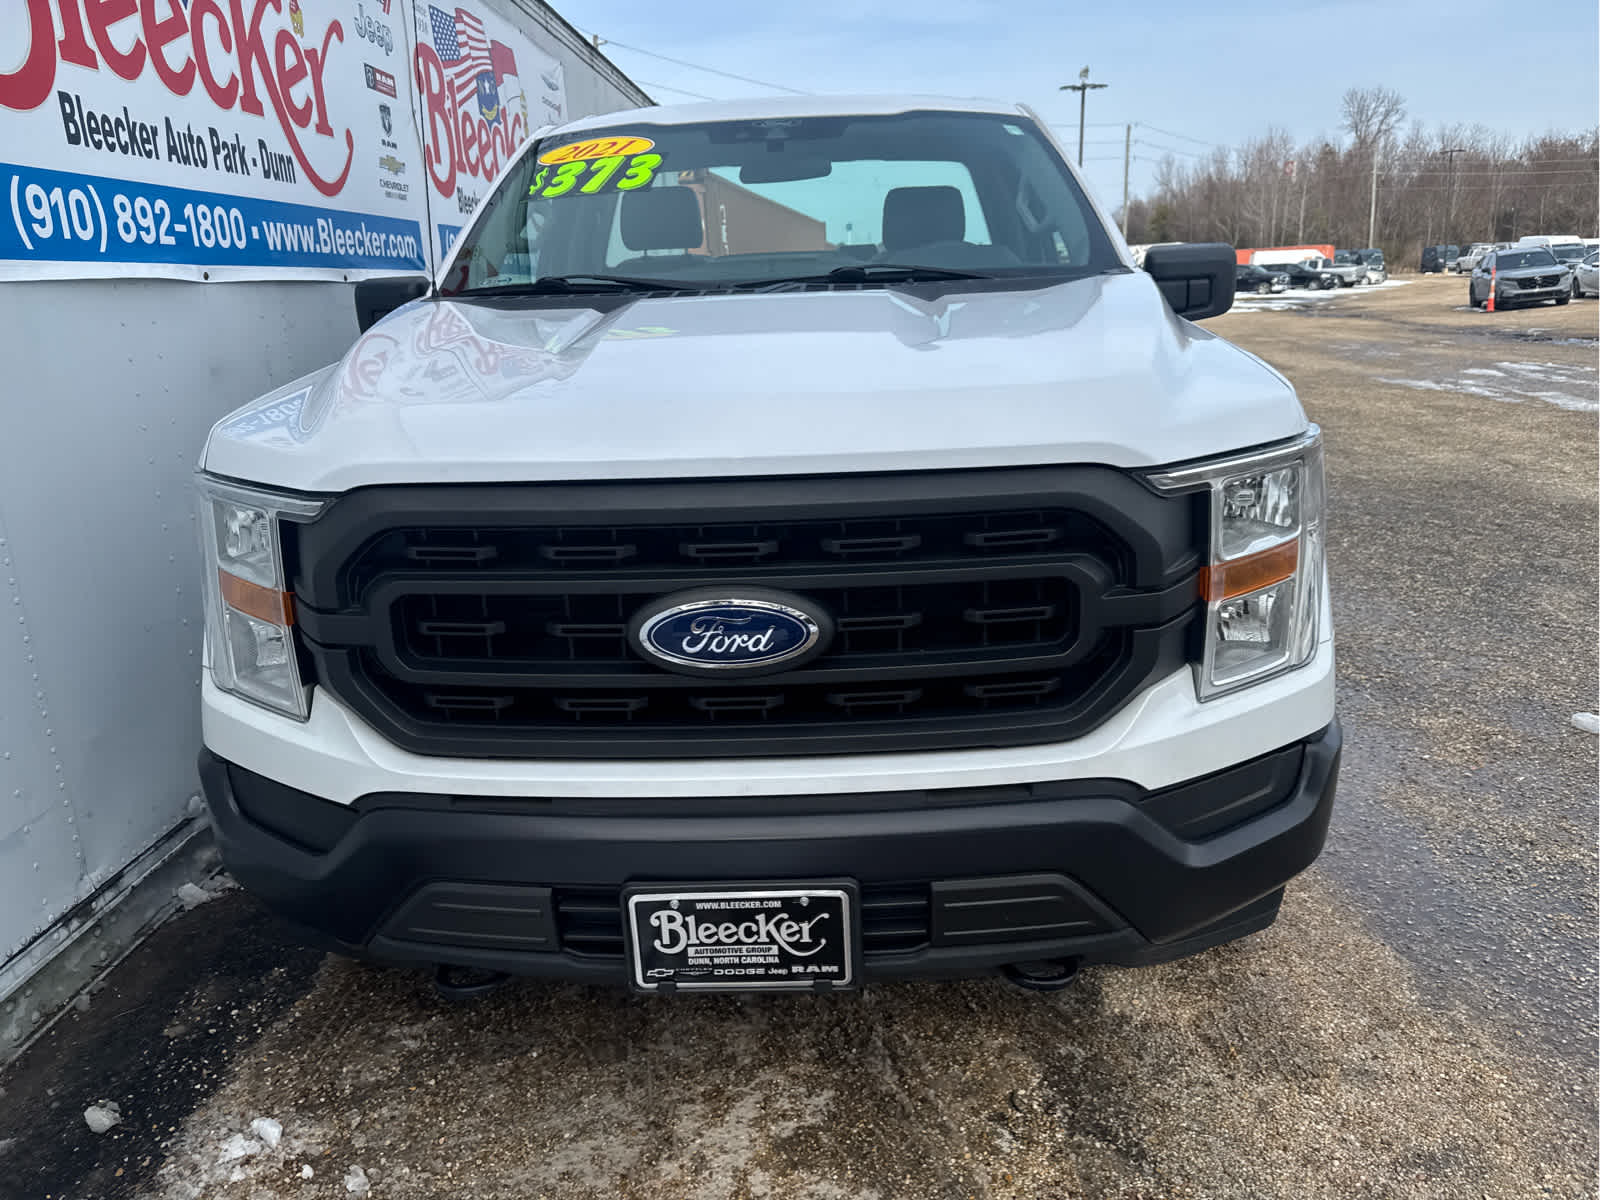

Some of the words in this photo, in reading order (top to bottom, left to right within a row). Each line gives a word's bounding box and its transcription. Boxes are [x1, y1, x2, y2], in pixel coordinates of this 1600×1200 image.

[354, 3, 393, 56] Jeep
[0, 0, 354, 197] eecker
[57, 90, 160, 160] Bleecker
[165, 116, 208, 169] Auto
[208, 127, 250, 176] Park
[257, 138, 297, 185] Dunn
[413, 42, 526, 198] Bleeck
[552, 140, 638, 162] 2021
[529, 153, 662, 197] $373
[10, 175, 108, 252] (910)
[113, 194, 246, 249] 892-1800
[262, 218, 417, 258] www.Bleecker.com
[682, 616, 776, 653] Ford
[696, 901, 782, 909] WWW.BLEECKER.COM
[650, 910, 830, 956] Bleecker
[694, 946, 745, 955] AUTOMOTIVE
[746, 946, 773, 954] GROUP
[688, 957, 712, 966] DUNN,
[713, 957, 739, 965] NORTH
[741, 956, 780, 964] CAROLINA
[713, 968, 766, 976] DODGE
[768, 967, 788, 976] Jeep
[792, 965, 839, 973] RAM
